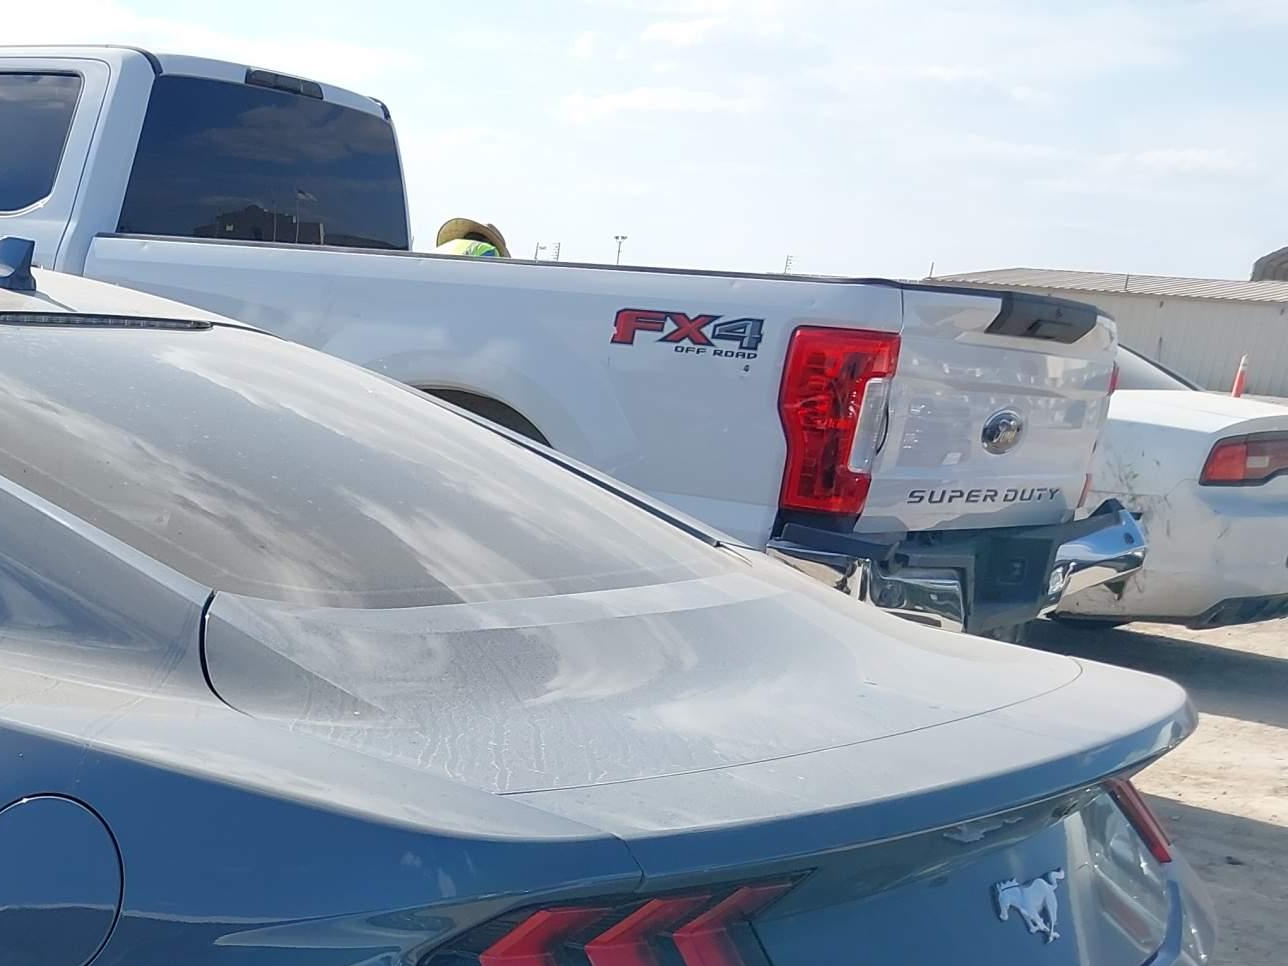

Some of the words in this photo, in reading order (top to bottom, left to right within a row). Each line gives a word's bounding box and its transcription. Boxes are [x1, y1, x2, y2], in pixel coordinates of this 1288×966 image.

[610, 308, 765, 351] FX4
[674, 345, 707, 355] OFF
[713, 349, 758, 360] ROAD
[907, 489, 998, 504] SUPER
[1004, 487, 1060, 503] DUTY
